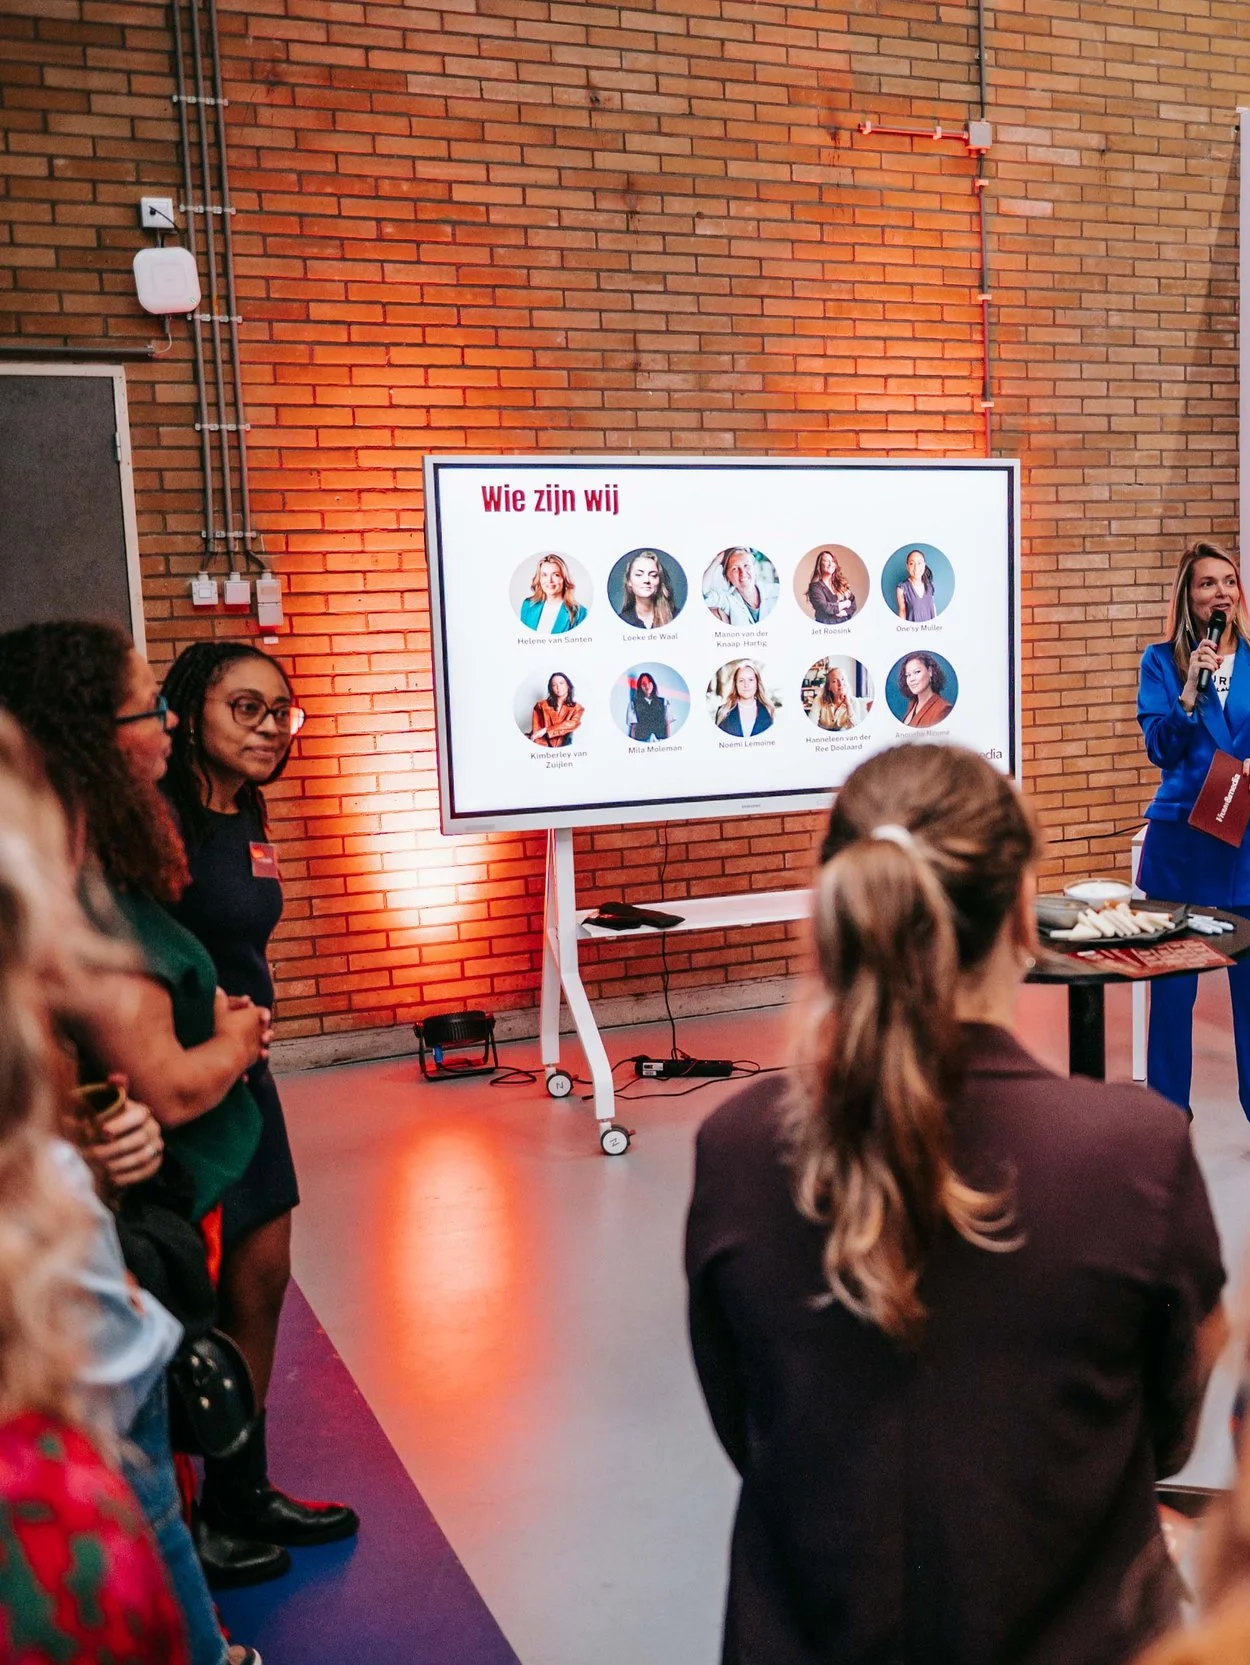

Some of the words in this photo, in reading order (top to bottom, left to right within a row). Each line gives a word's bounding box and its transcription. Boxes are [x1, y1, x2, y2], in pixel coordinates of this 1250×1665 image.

[481, 484, 526, 512] Wie
[534, 484, 576, 516] zijn
[584, 484, 619, 515] wij
[647, 633, 658, 641] de
[756, 629, 768, 637] der
[564, 636, 593, 644] Santen
[744, 740, 776, 748] Lemoine
[647, 745, 682, 753] Moleman
[530, 751, 571, 760] Kimberley
[545, 761, 573, 769] Zuijlen
